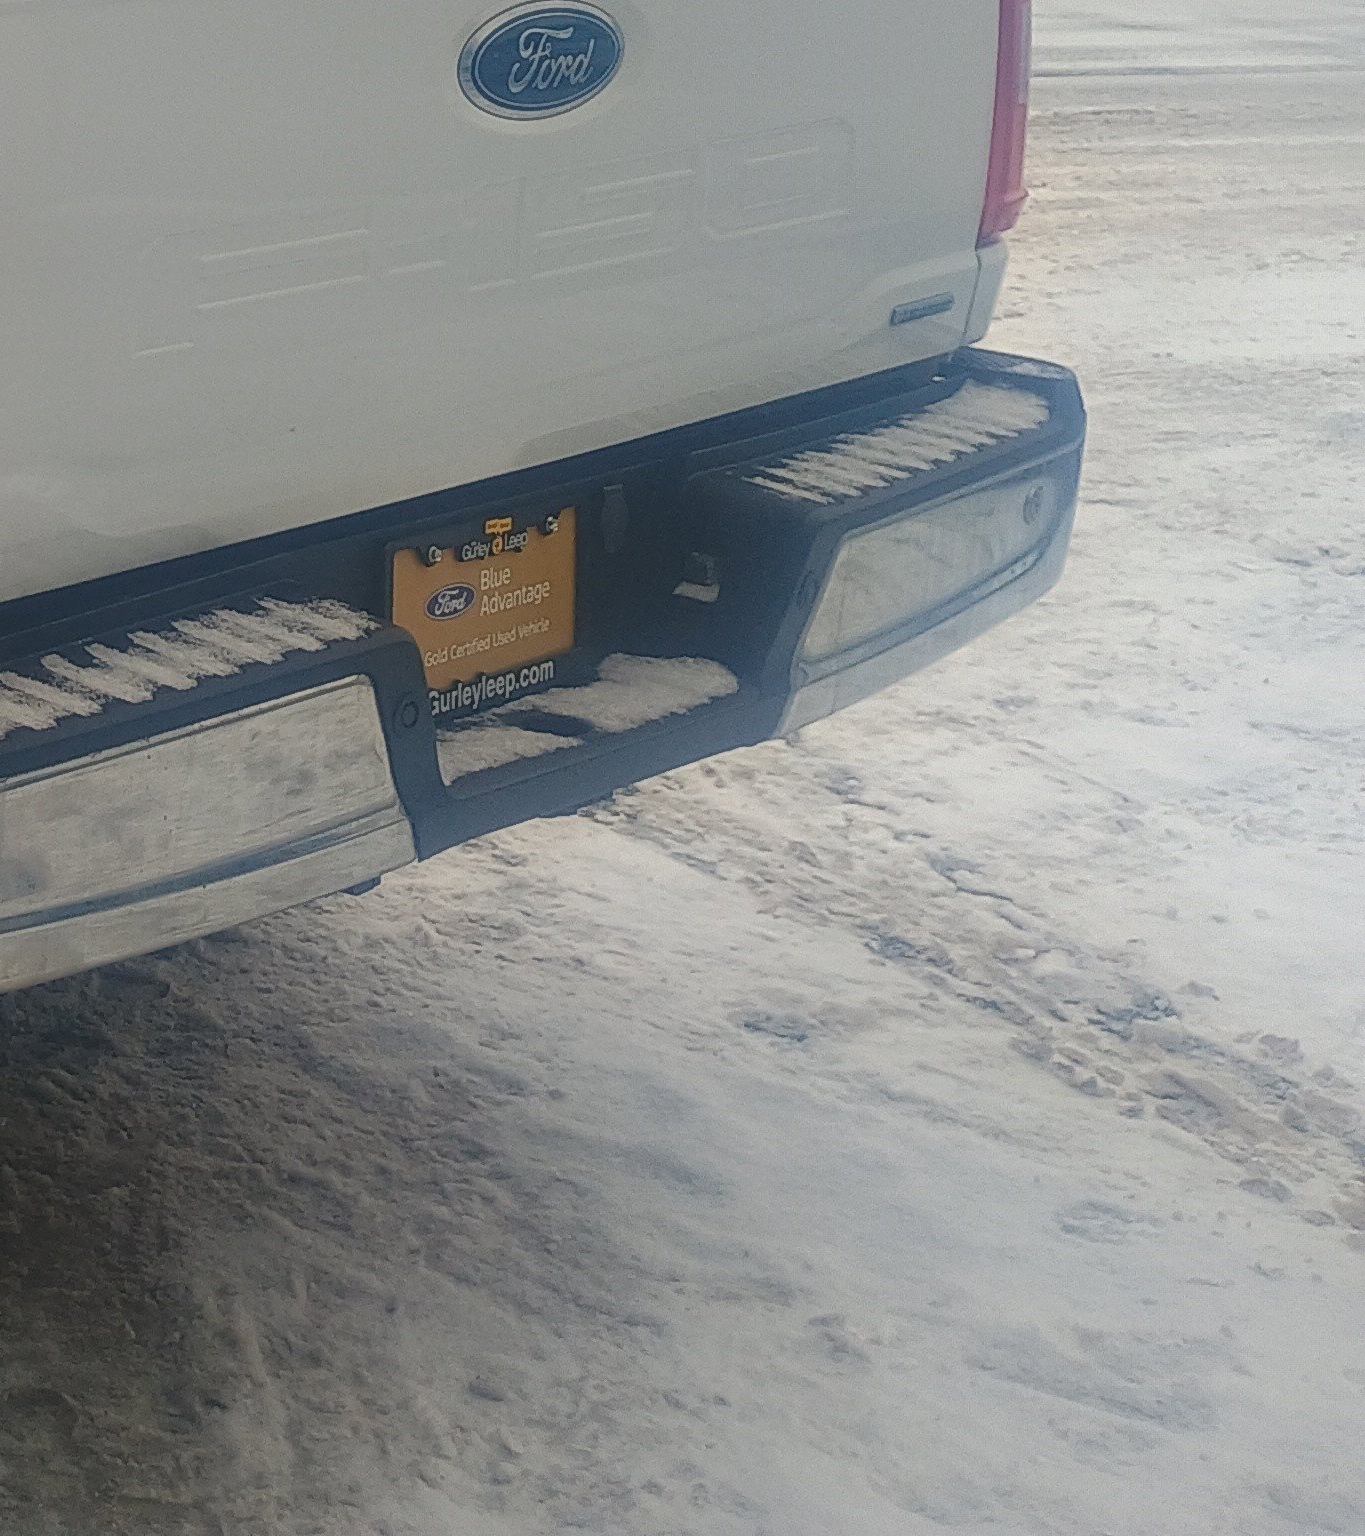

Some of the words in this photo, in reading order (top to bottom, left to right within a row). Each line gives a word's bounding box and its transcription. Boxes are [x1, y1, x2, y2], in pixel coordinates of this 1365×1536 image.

[507, 26, 595, 94] Ford
[480, 567, 511, 591] Blue
[434, 588, 468, 615] Ford
[479, 581, 551, 617] Advantage
[424, 647, 449, 667] Gold
[450, 634, 491, 659] Certified
[492, 625, 517, 647] Used
[518, 617, 550, 639] Vehicle
